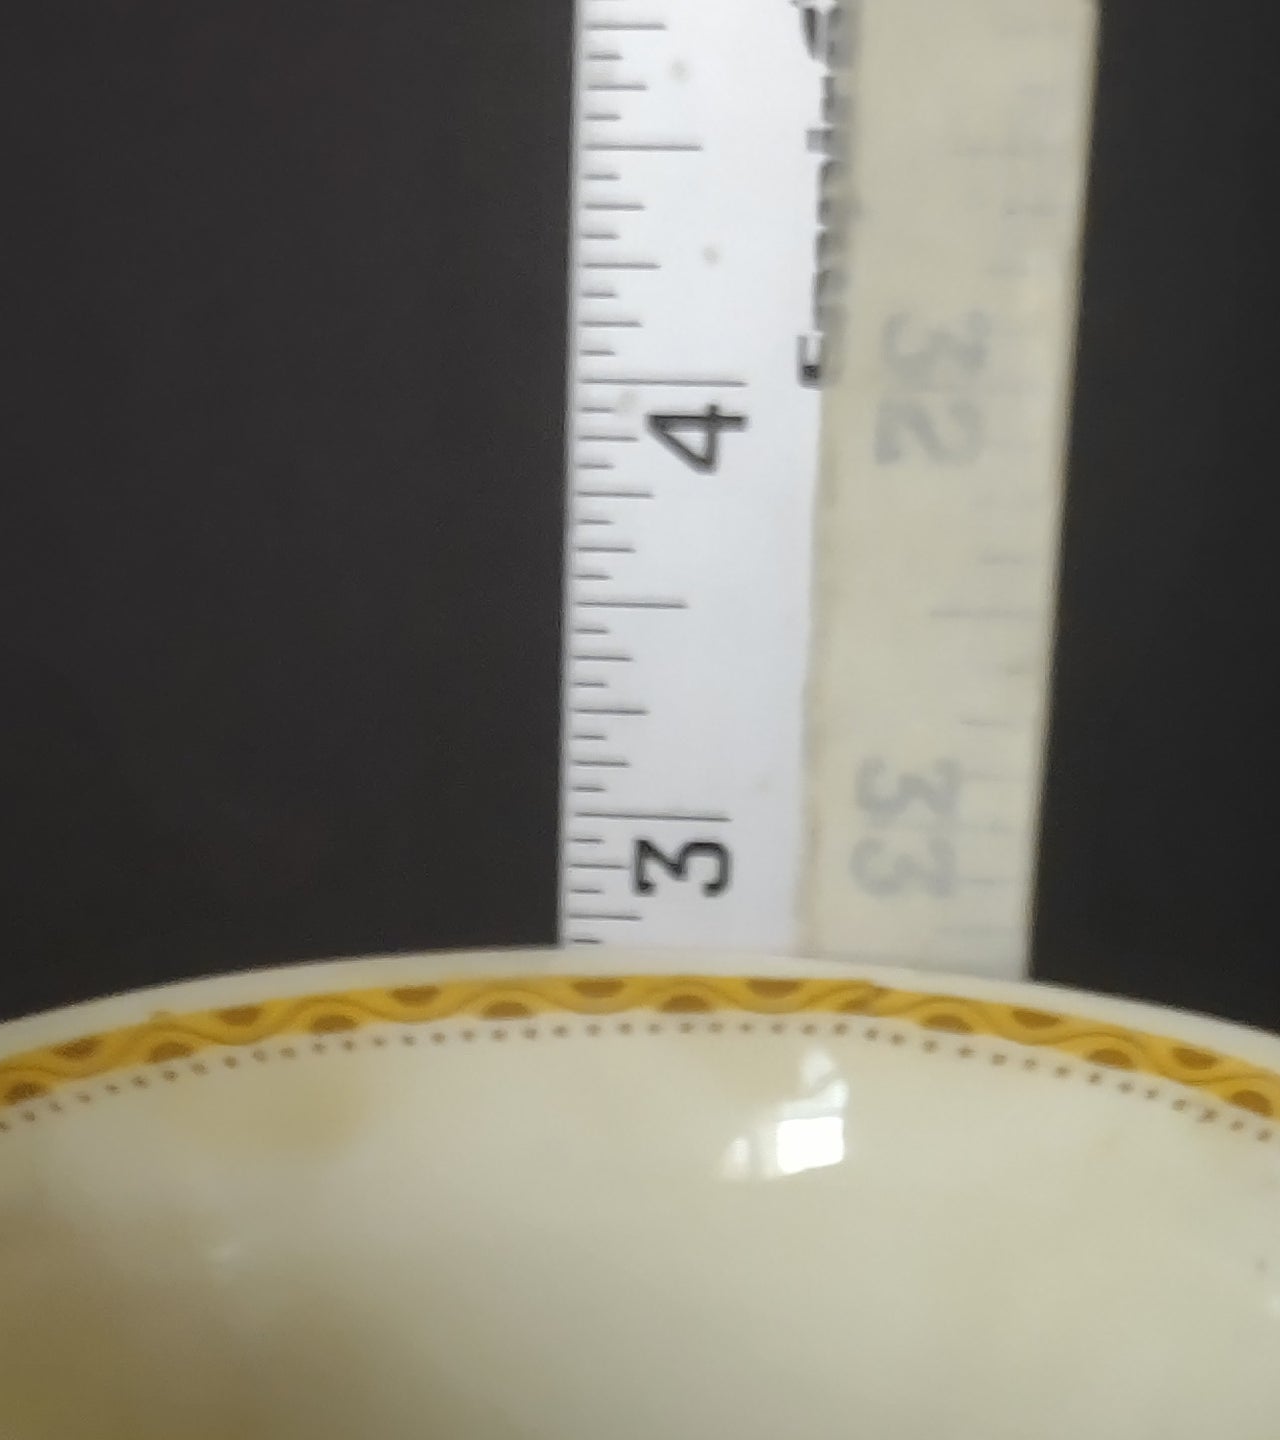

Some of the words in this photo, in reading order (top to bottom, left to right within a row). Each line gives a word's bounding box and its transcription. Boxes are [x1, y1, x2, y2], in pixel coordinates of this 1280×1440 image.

[647, 403, 748, 473] 4
[874, 311, 990, 467] 32
[633, 837, 732, 897] 3
[852, 756, 961, 899] 33
